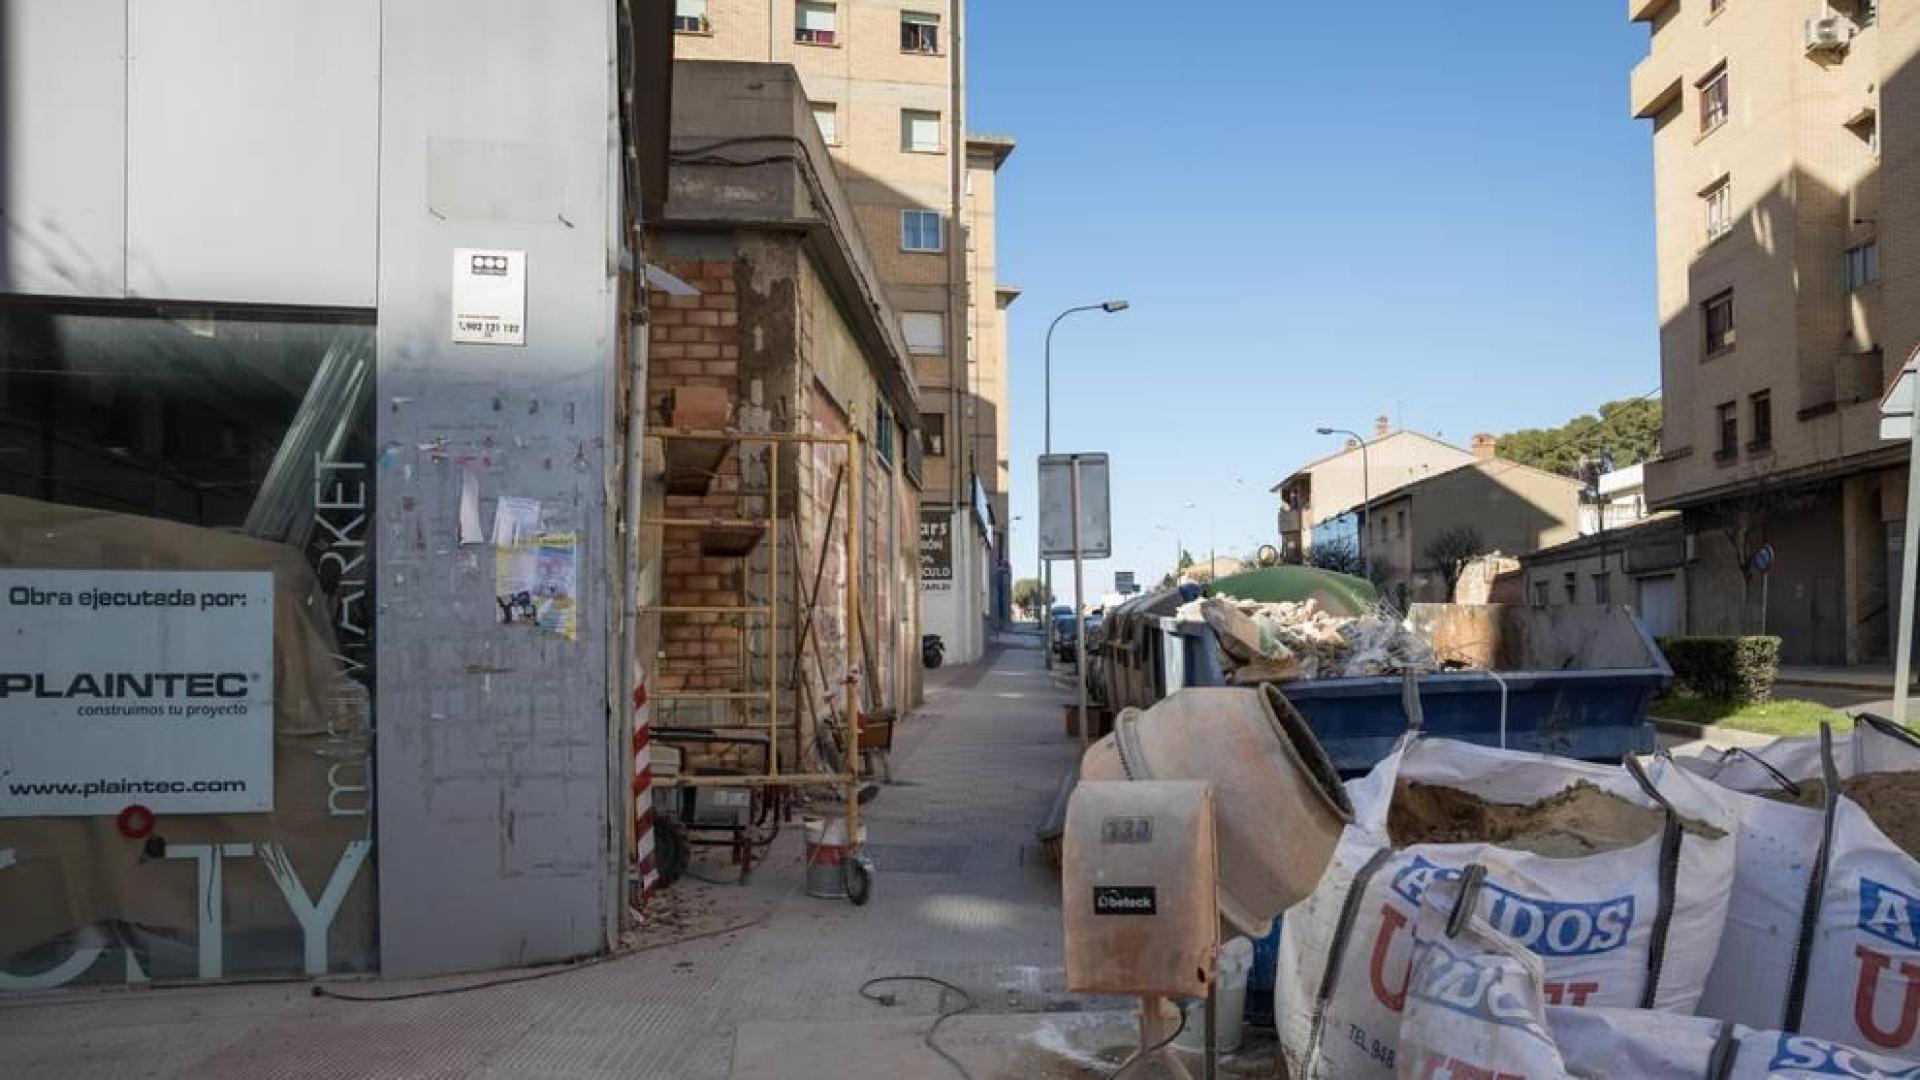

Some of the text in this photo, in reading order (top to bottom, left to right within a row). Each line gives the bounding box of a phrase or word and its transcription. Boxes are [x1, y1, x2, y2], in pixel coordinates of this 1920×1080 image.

[9, 586, 248, 611] Obra ejecutada por:
[77, 702, 248, 719] construimos tu proyecto
[9, 777, 247, 800] www.plaintec.com
